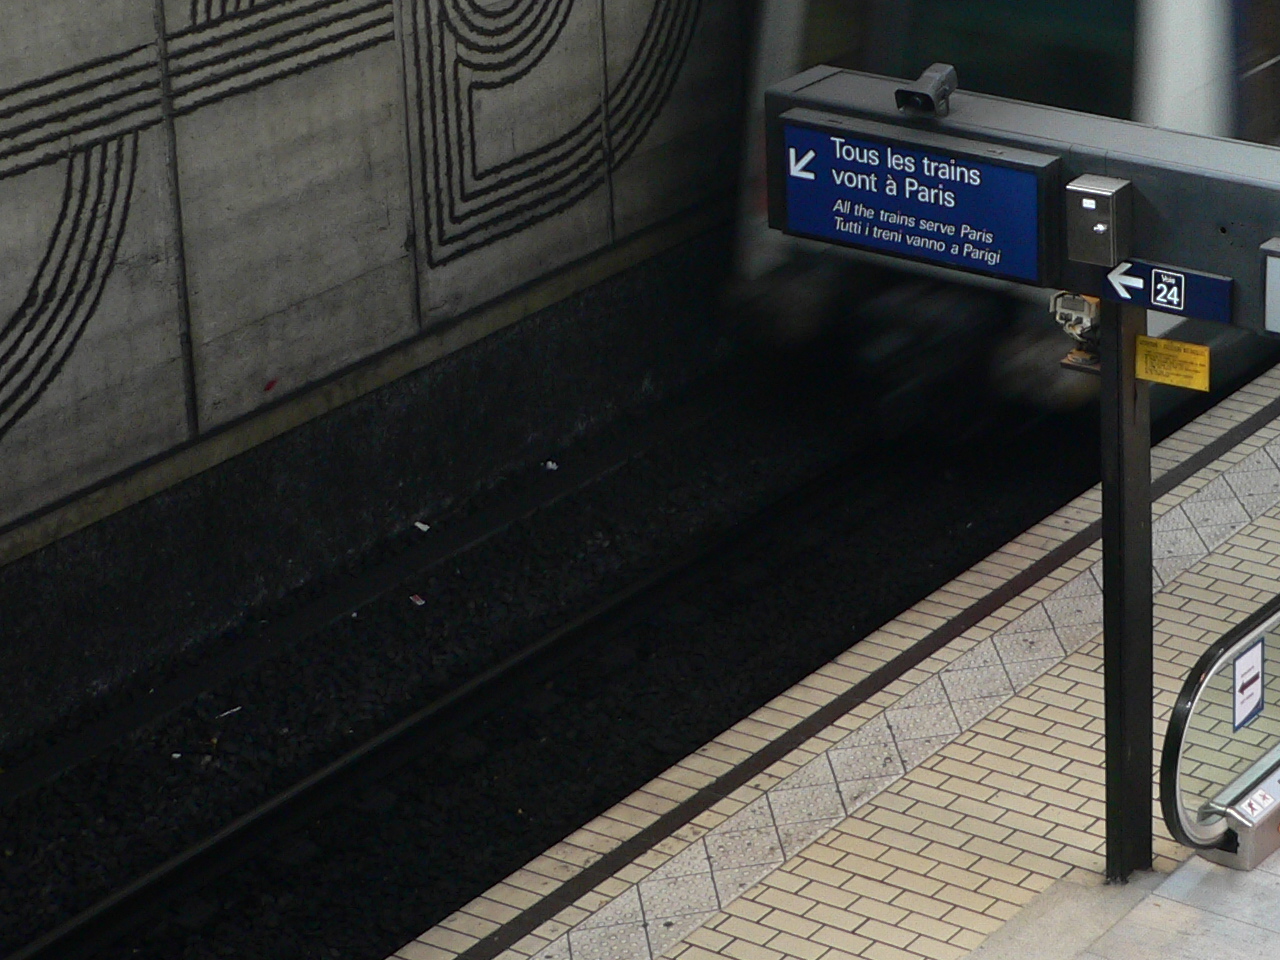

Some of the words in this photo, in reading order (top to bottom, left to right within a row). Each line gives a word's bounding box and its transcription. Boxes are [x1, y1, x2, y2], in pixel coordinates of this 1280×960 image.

[830, 136, 879, 167] Tous
[887, 147, 915, 172] les
[922, 158, 982, 186] trains
[831, 169, 878, 192] vont
[885, 174, 897, 196] à
[905, 178, 955, 208] Paris
[832, 199, 850, 214] All
[854, 202, 874, 219] the
[880, 209, 915, 228] trains
[919, 218, 955, 237] serve
[960, 224, 994, 244] Paris
[834, 216, 862, 235] Tutti
[864, 222, 870, 236] i
[873, 225, 902, 243] treni
[906, 234, 945, 252] vanno
[950, 242, 959, 254] a
[963, 244, 1001, 266] Parigi
[1156, 283, 1179, 305] 24
